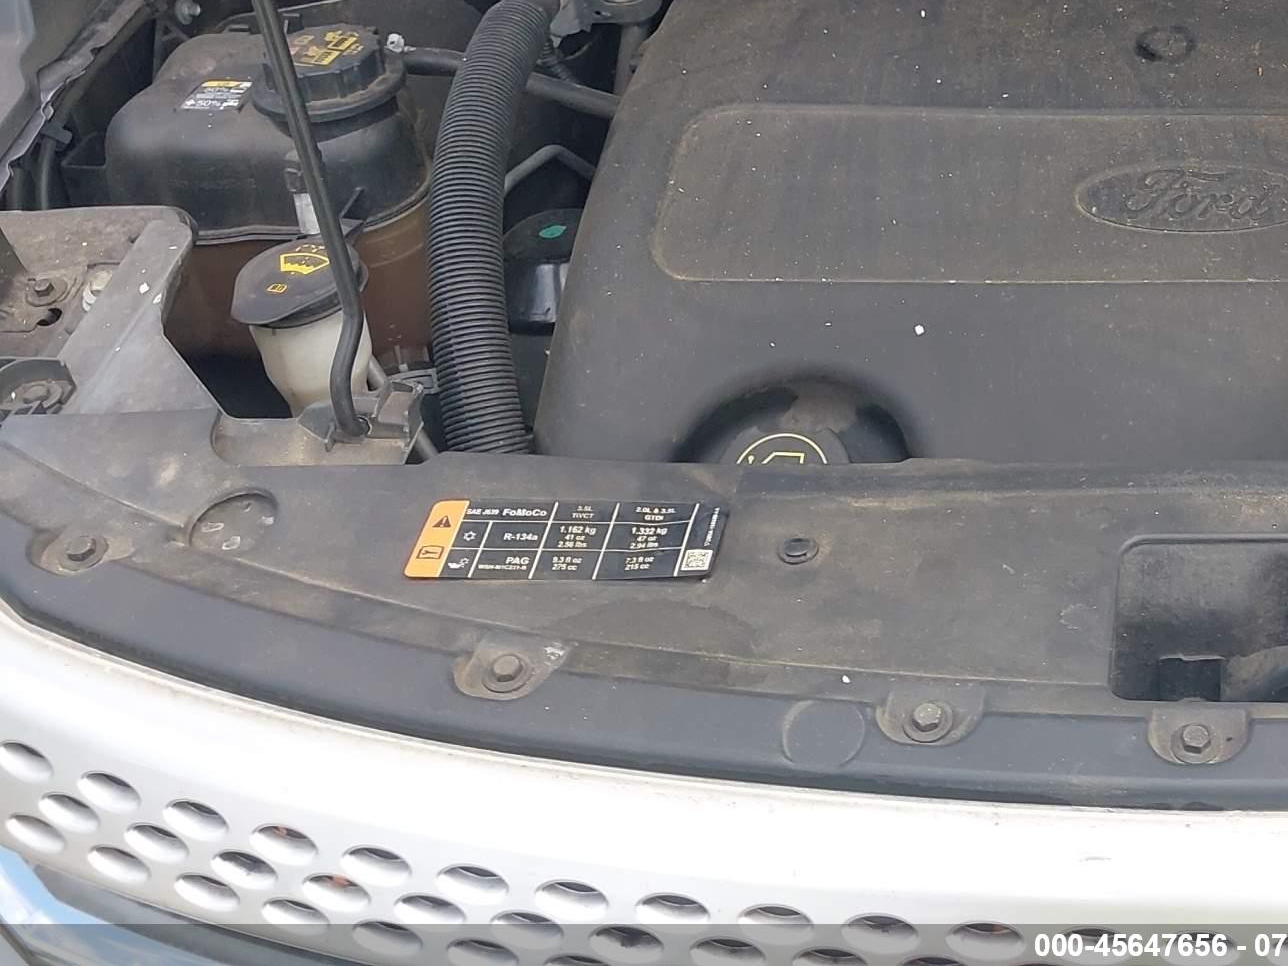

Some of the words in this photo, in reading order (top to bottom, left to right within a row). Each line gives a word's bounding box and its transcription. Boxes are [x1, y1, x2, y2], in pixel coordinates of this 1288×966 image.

[1121, 168, 1281, 221] Ford
[502, 508, 547, 517] FoMoCo
[560, 525, 584, 534] 1.162
[584, 525, 597, 536] kg
[631, 526, 656, 535] 1.332
[655, 527, 668, 536] kg
[503, 532, 539, 541] R-134a
[505, 556, 530, 565] PAG
[551, 563, 567, 571] 275
[624, 563, 639, 571] 215
